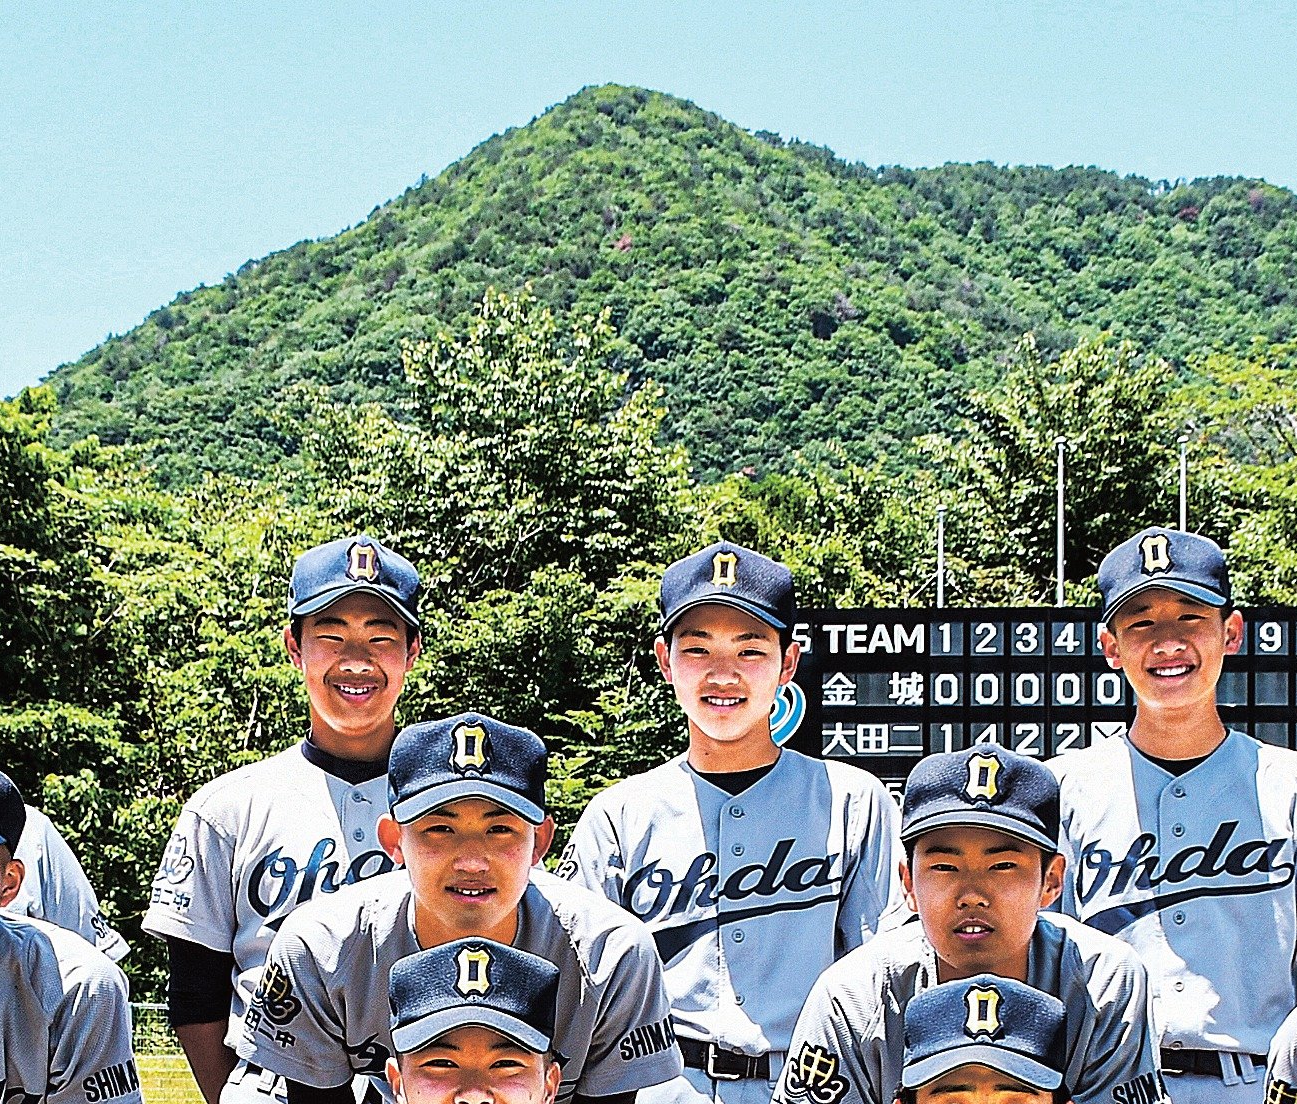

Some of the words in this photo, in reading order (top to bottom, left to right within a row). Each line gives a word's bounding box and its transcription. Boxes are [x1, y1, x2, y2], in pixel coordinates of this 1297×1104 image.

[822, 624, 924, 653] TEAM
[938, 623, 951, 653] 1
[974, 623, 997, 652] 2
[1015, 623, 1038, 652] 3
[1054, 623, 1080, 652] 4
[1259, 622, 1282, 652] 9
[934, 673, 958, 705] 0
[974, 673, 998, 705] 0
[1015, 673, 1039, 705] 0
[1056, 673, 1080, 705] 0
[1096, 673, 1120, 705] 0
[821, 722, 924, 755] 大田二
[940, 723, 952, 752] 1
[974, 723, 997, 746] 4
[1015, 723, 1040, 755] 2
[1055, 723, 1079, 753] 2
[1076, 821, 1295, 900] Ohda
[621, 839, 845, 921] Ohda
